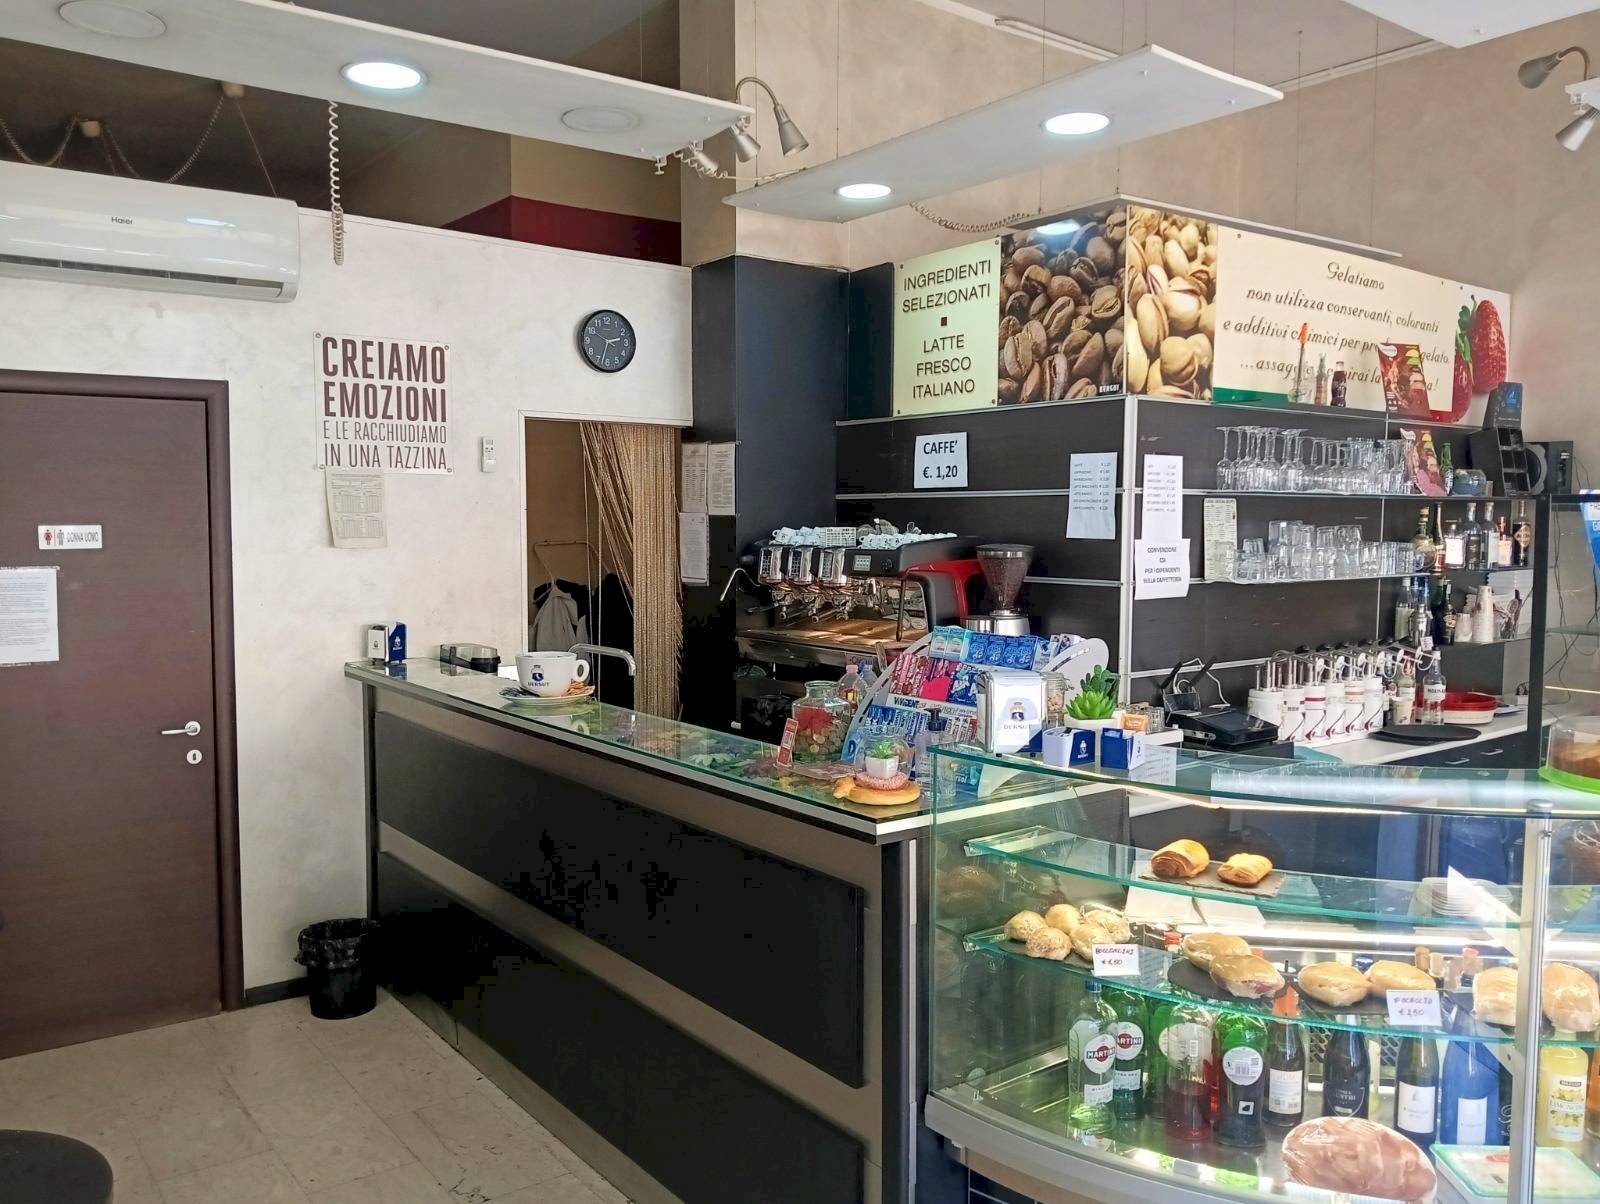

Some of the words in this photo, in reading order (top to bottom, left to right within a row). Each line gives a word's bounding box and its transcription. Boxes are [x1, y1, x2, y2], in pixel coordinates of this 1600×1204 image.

[111, 216, 133, 225] Haier
[903, 259, 991, 291] INGREDIENTI
[1327, 261, 1385, 290] Gelatiamo
[902, 283, 991, 313] SELEZIONATI
[1246, 289, 1272, 302] non
[1275, 288, 1325, 311] utilizza
[1327, 302, 1392, 326] conservanti,
[1395, 311, 1440, 333] coloranti
[923, 333, 965, 353] LATTE
[1223, 320, 1231, 330] e
[1234, 315, 1291, 339] additivi
[1290, 328, 1341, 346] cimici
[1340, 335, 1361, 351] per
[322, 336, 446, 384] CREIAMO
[916, 356, 972, 376] FRESCO
[913, 378, 975, 399] ITALIANO
[323, 381, 447, 423] EMOZIONI
[323, 420, 330, 439] E
[335, 420, 349, 440] LE
[354, 421, 447, 444] RACCHIUDIAMO
[324, 443, 341, 467] IN
[348, 443, 381, 468] UNA
[386, 445, 447, 470] TAZZINA
[923, 440, 958, 455] CAFFE'
[936, 465, 958, 480] 1,20
[84, 532, 99, 542] UOMO
[1116, 1036, 1142, 1046] ARTINI
[1086, 1046, 1116, 1060] MARTINI
